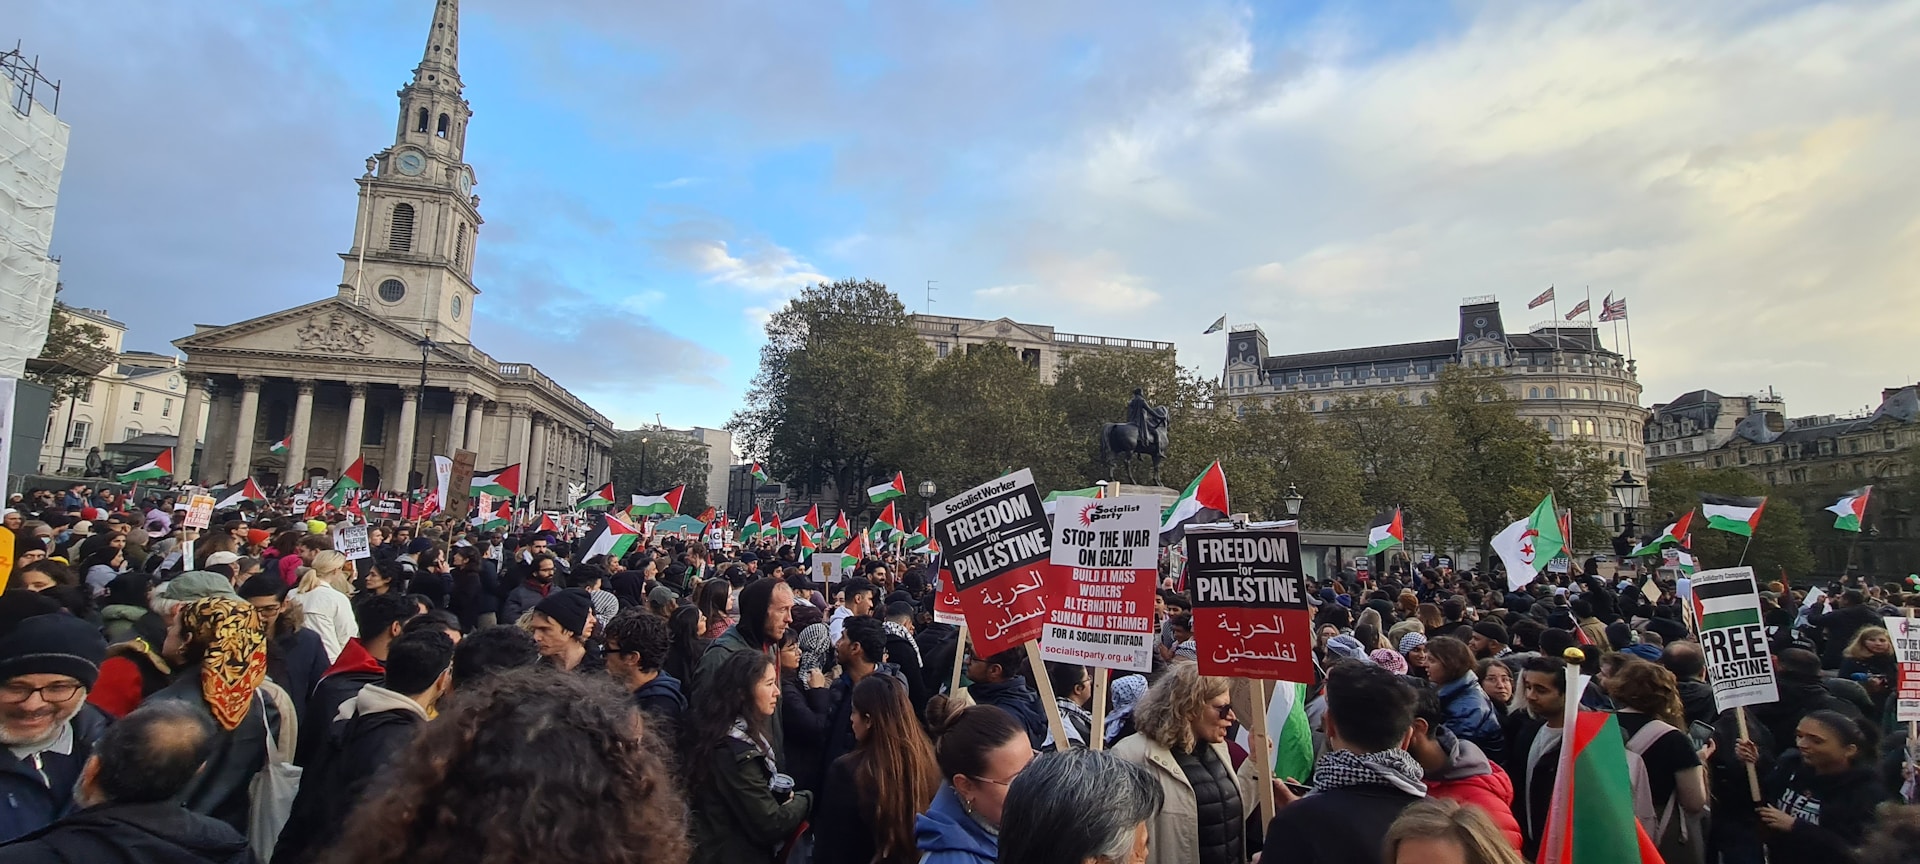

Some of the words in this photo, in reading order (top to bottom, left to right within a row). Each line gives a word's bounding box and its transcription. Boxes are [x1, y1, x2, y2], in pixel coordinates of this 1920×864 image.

[945, 491, 982, 515] Socialist
[981, 480, 1016, 498] Worker
[946, 493, 1032, 546] FREEDOM
[1095, 505, 1140, 514] Socialist
[986, 531, 1000, 544] for
[1062, 528, 1095, 547] STOP
[1099, 530, 1118, 547] THE
[1123, 530, 1150, 547] WAR
[954, 528, 1050, 585] PALESTINE
[1079, 549, 1096, 567] ON
[1100, 549, 1133, 567] GAZA!
[1197, 537, 1290, 564] FREEDOM
[1072, 568, 1099, 583] BUILD
[1101, 570, 1108, 582] A
[1109, 570, 1135, 583] MASS
[1237, 563, 1253, 576] for
[980, 570, 1043, 608] الحرية
[1196, 576, 1300, 604] PALESTINE
[1064, 596, 1122, 614] ALTERNATIVE
[1125, 601, 1136, 614] TO
[1051, 610, 1083, 626] SUNAK
[1086, 614, 1104, 628] AND
[1106, 615, 1148, 631] STARMER
[1217, 613, 1285, 639] الحرية
[1052, 628, 1067, 640] FOR
[1069, 630, 1075, 640] A
[1077, 631, 1112, 644] SOCIALIST
[1113, 634, 1143, 647] INTIFADA
[1701, 625, 1767, 667] FREE
[1045, 645, 1133, 663] socialistparty.org.uk
[1212, 639, 1297, 663] لفلسطين
